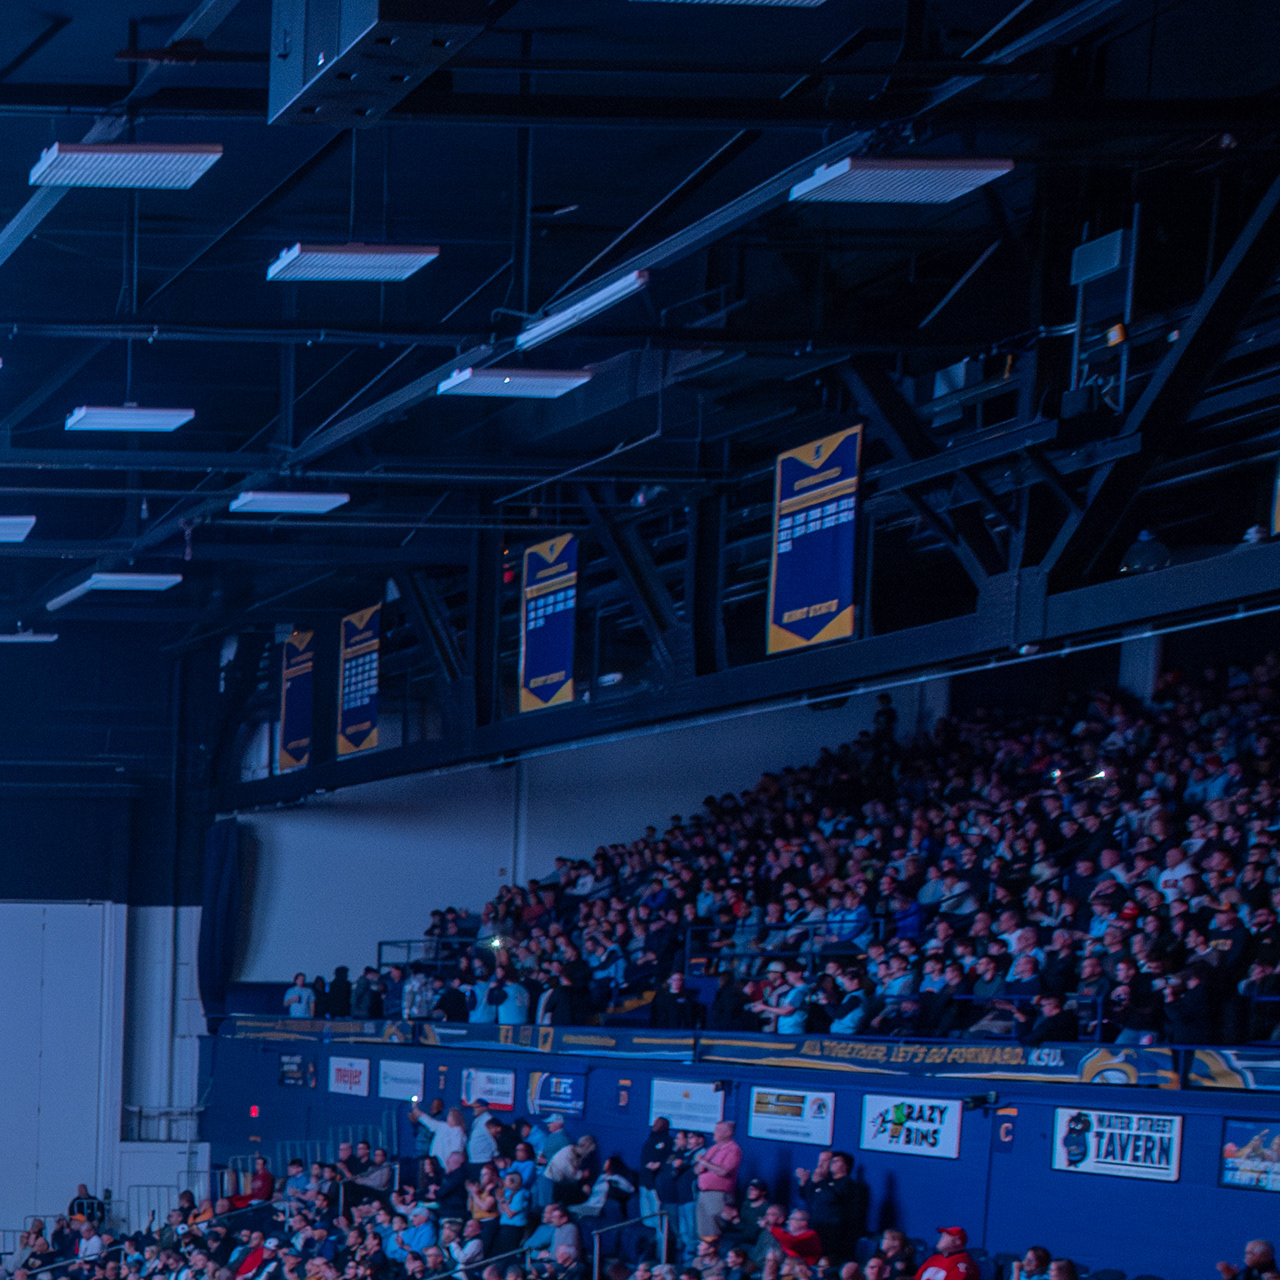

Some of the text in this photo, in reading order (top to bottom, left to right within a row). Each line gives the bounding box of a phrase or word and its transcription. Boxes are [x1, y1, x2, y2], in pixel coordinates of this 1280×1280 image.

[800, 1039, 822, 1056] ALL
[924, 1047, 948, 1064] GO
[1027, 1048, 1065, 1067] KSU.
[903, 1124, 940, 1148] BINS
[1095, 1112, 1173, 1134] WATER STREET
[1094, 1131, 1172, 1166] TAVERN
